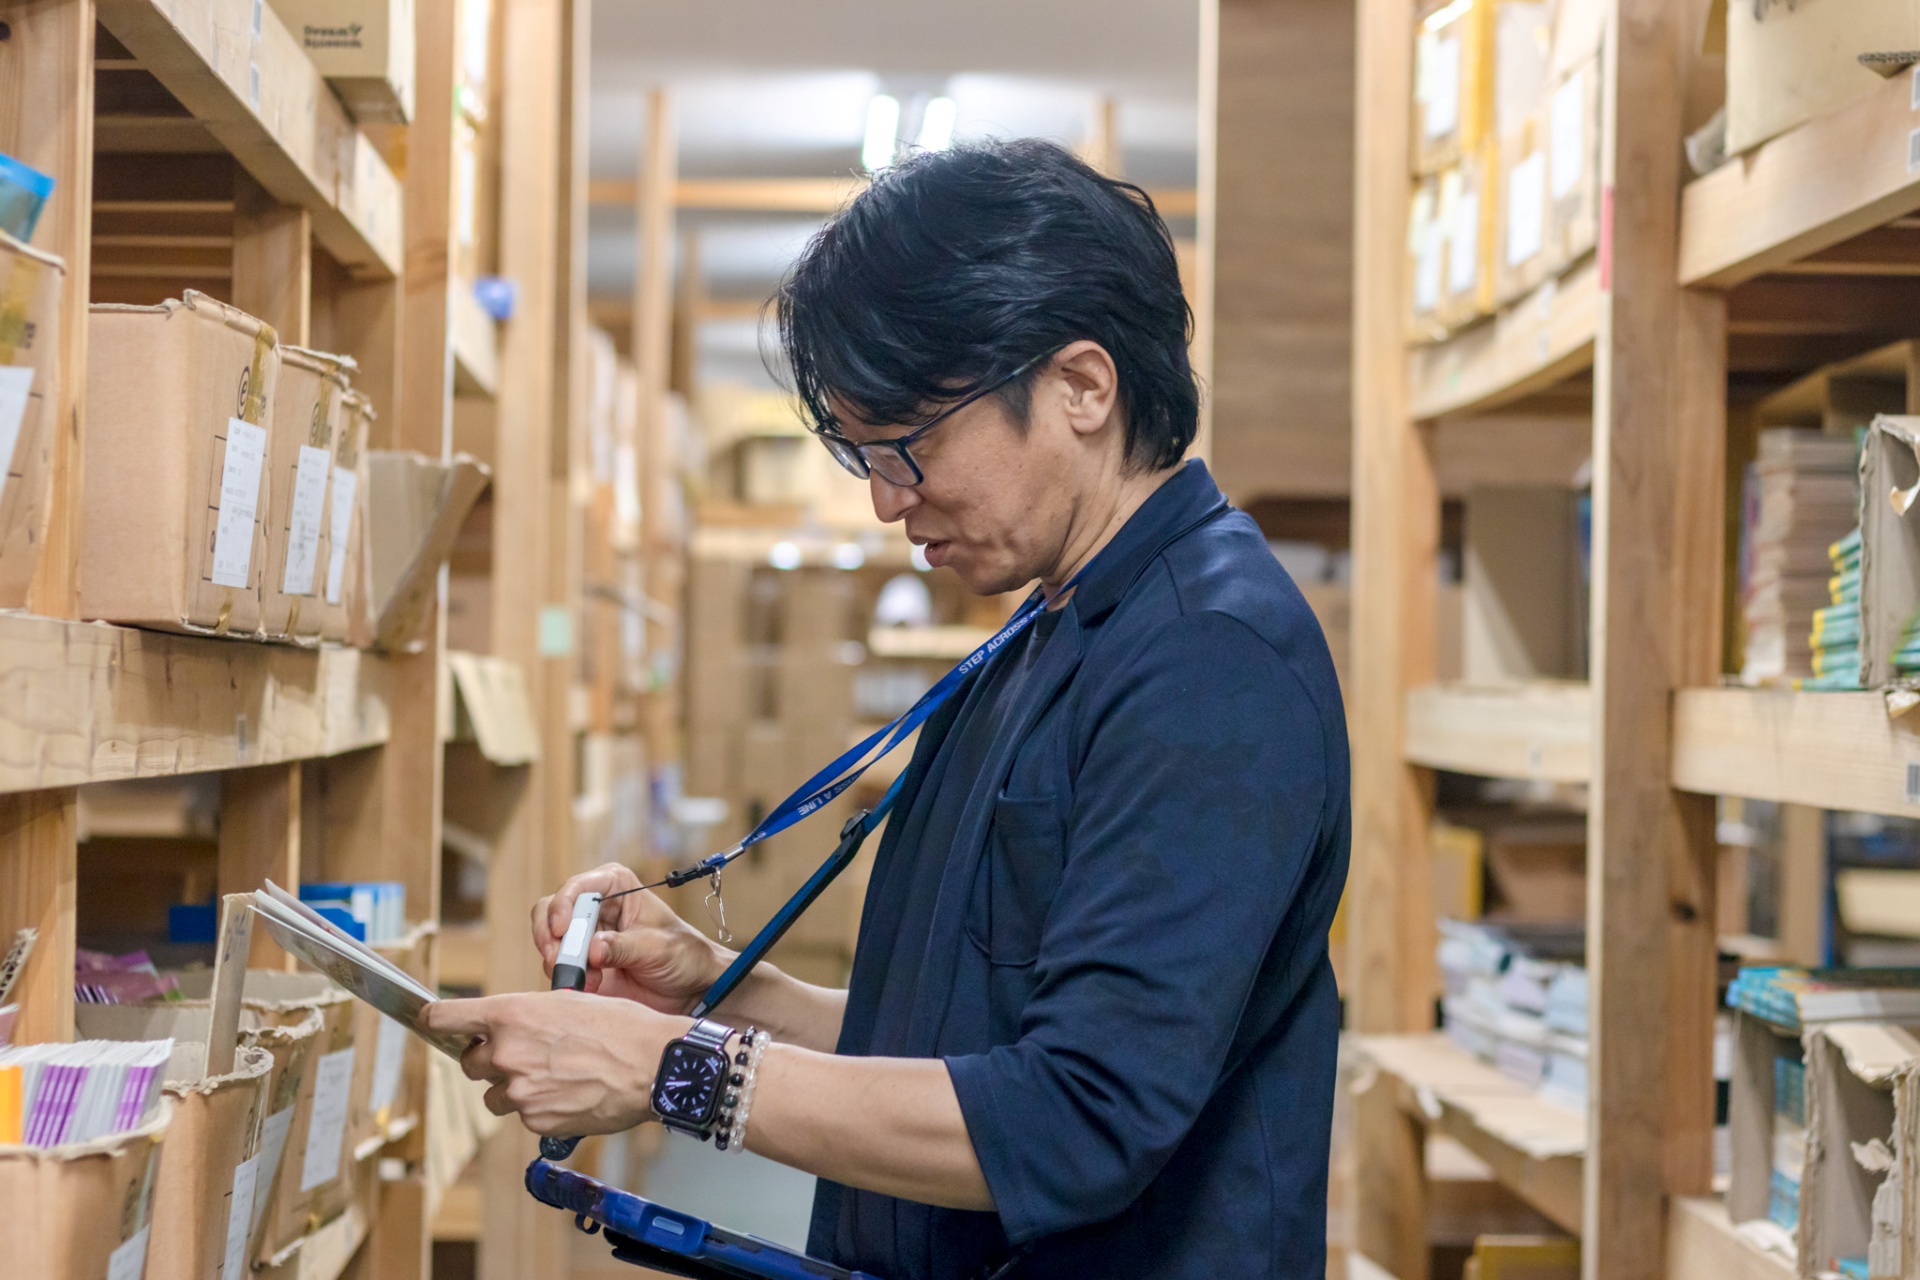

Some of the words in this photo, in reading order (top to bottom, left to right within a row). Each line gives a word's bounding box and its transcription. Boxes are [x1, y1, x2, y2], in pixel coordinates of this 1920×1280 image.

[958, 650, 985, 674] STEP
[987, 617, 1028, 653] ACROSS
[823, 791, 832, 800] A
[797, 797, 823, 816] LINE
